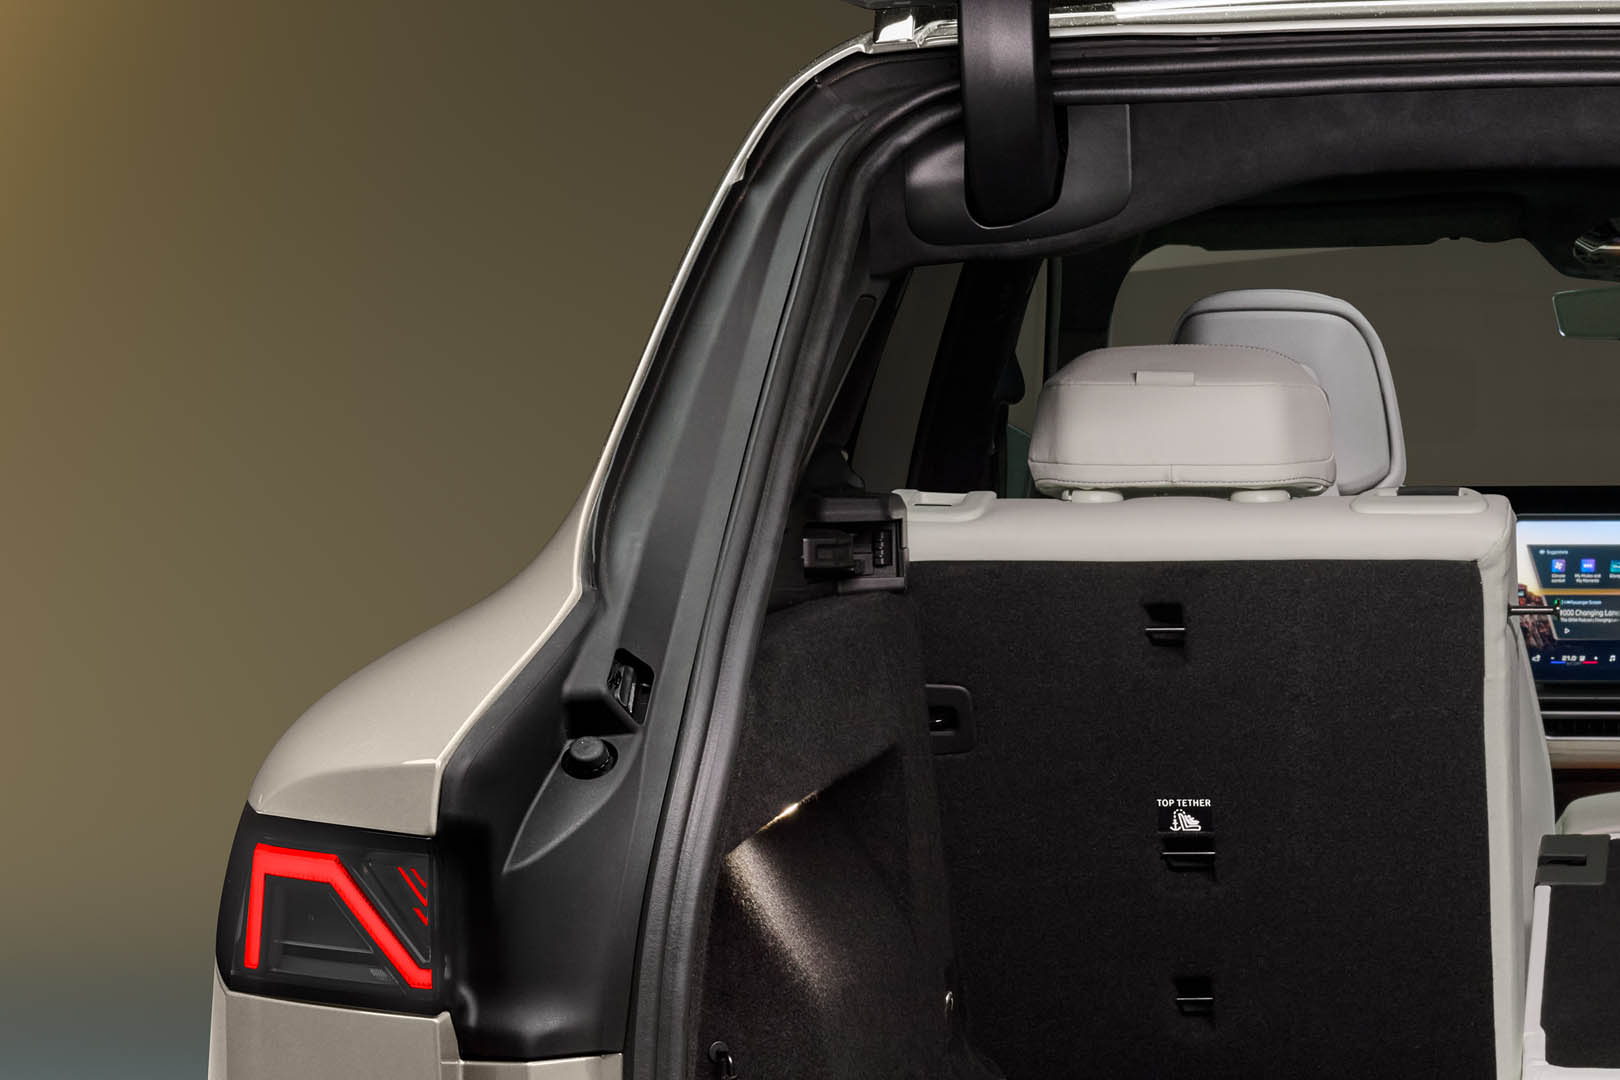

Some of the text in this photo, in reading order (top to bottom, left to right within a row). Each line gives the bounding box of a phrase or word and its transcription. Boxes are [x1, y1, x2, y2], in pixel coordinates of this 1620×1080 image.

[1575, 609, 1604, 617] Changing
[1156, 798, 1211, 807] TOP TETHER
